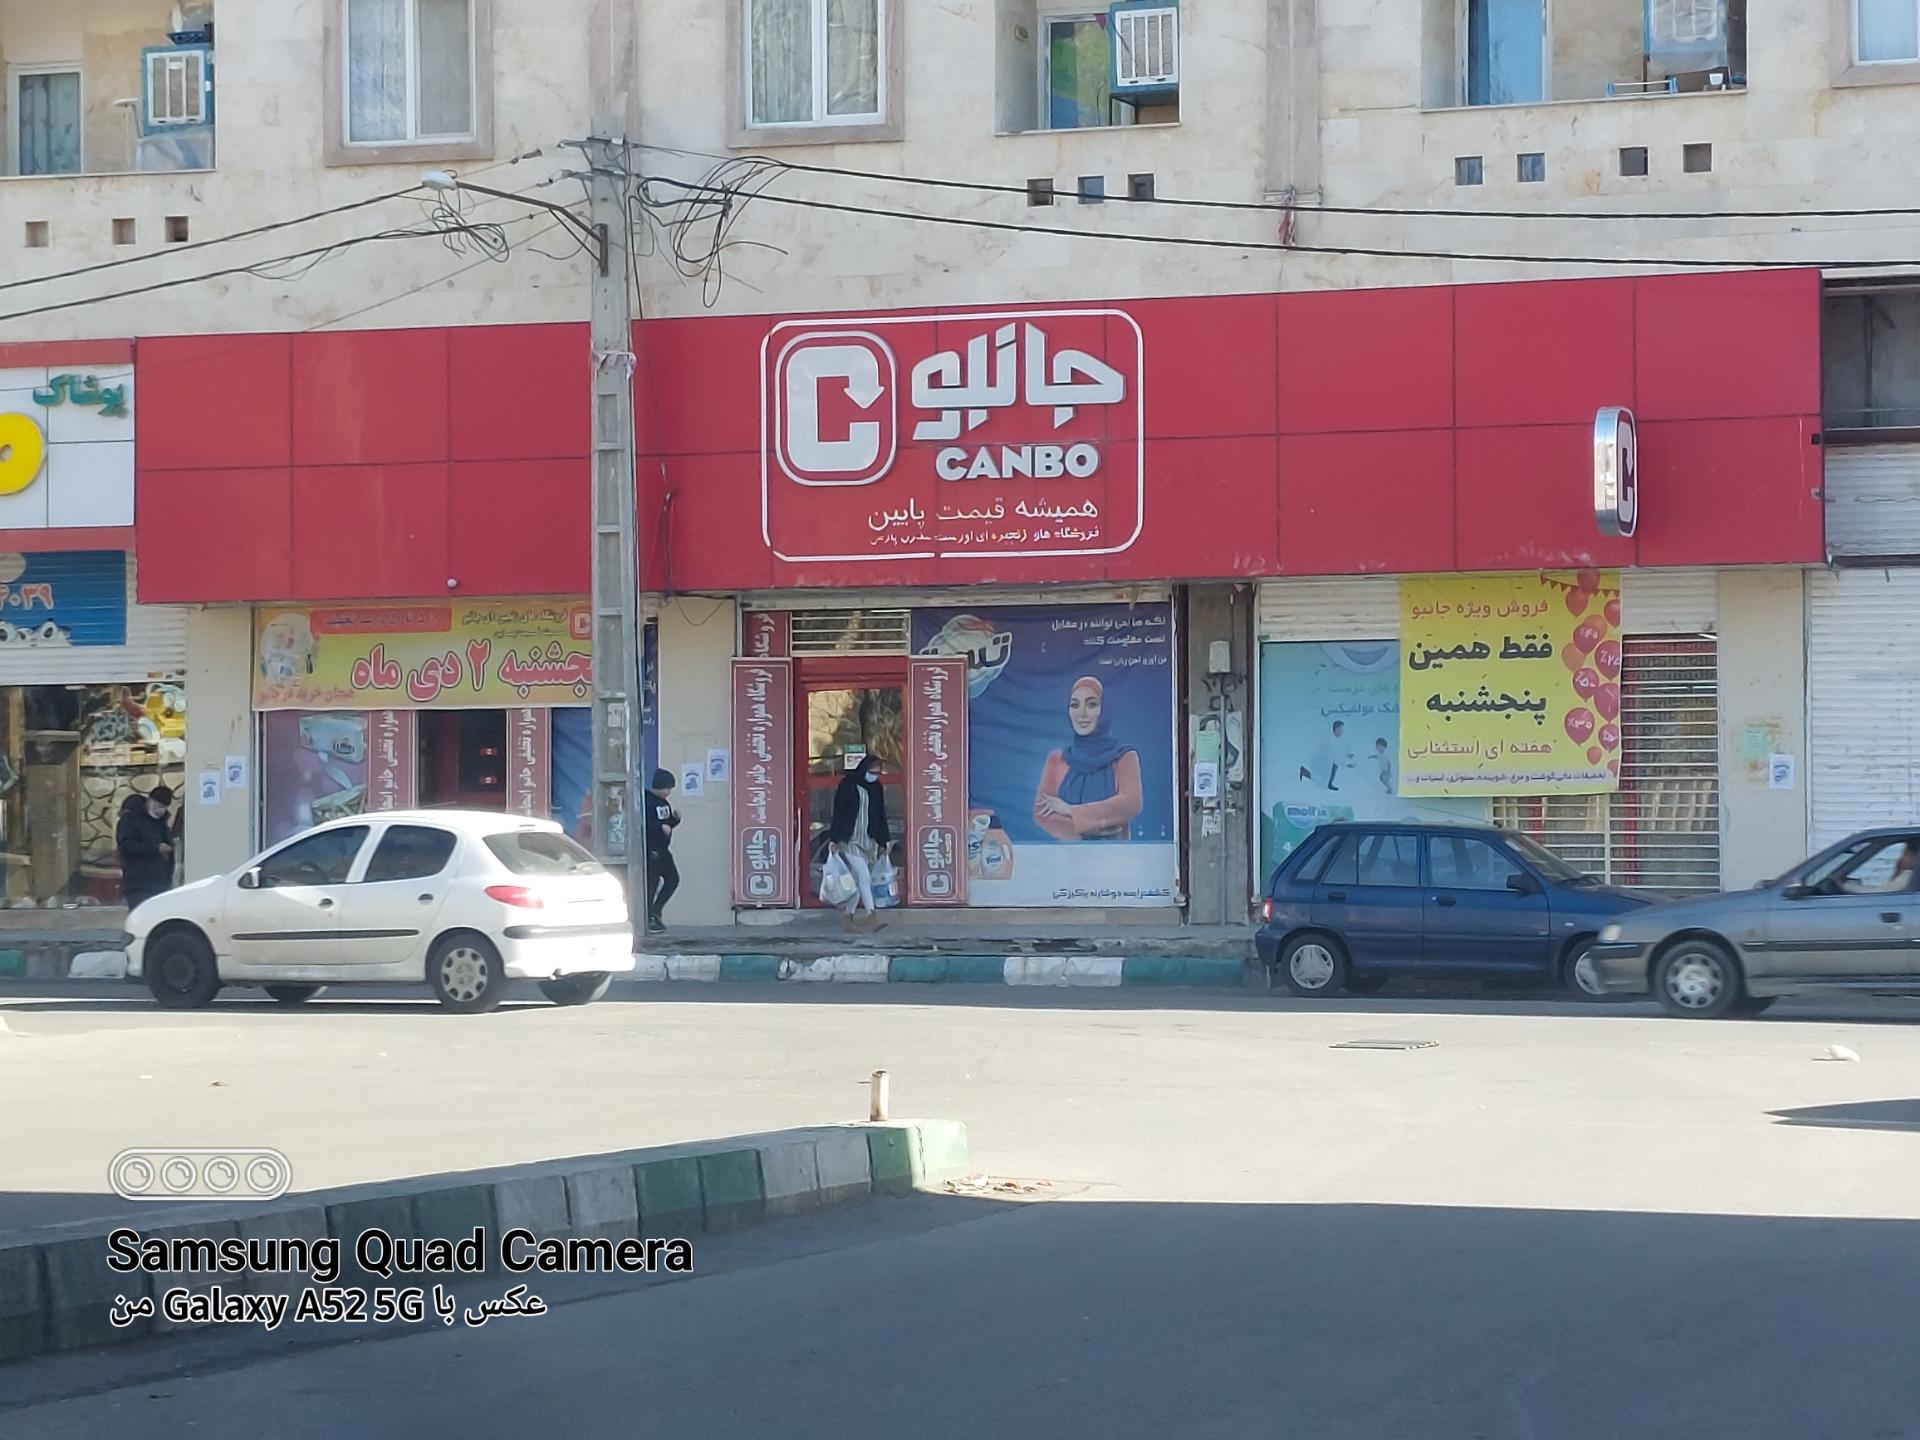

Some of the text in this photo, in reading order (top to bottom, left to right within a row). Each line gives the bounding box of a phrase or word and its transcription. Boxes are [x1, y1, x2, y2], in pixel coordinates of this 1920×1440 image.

[33, 374, 128, 418] پوشاک
[935, 443, 1099, 482] CANBO
[867, 497, 1099, 531] همیشه قیمت پایین
[1411, 598, 1548, 620] فروش ویژه جانبو
[351, 642, 402, 690] ماه
[467, 638, 492, 691] ۲
[1408, 632, 1553, 671] فقط همین
[406, 651, 462, 702] دی
[1426, 685, 1547, 726] پنجشنبه
[1407, 739, 1552, 759] هفته ای استثنایی
